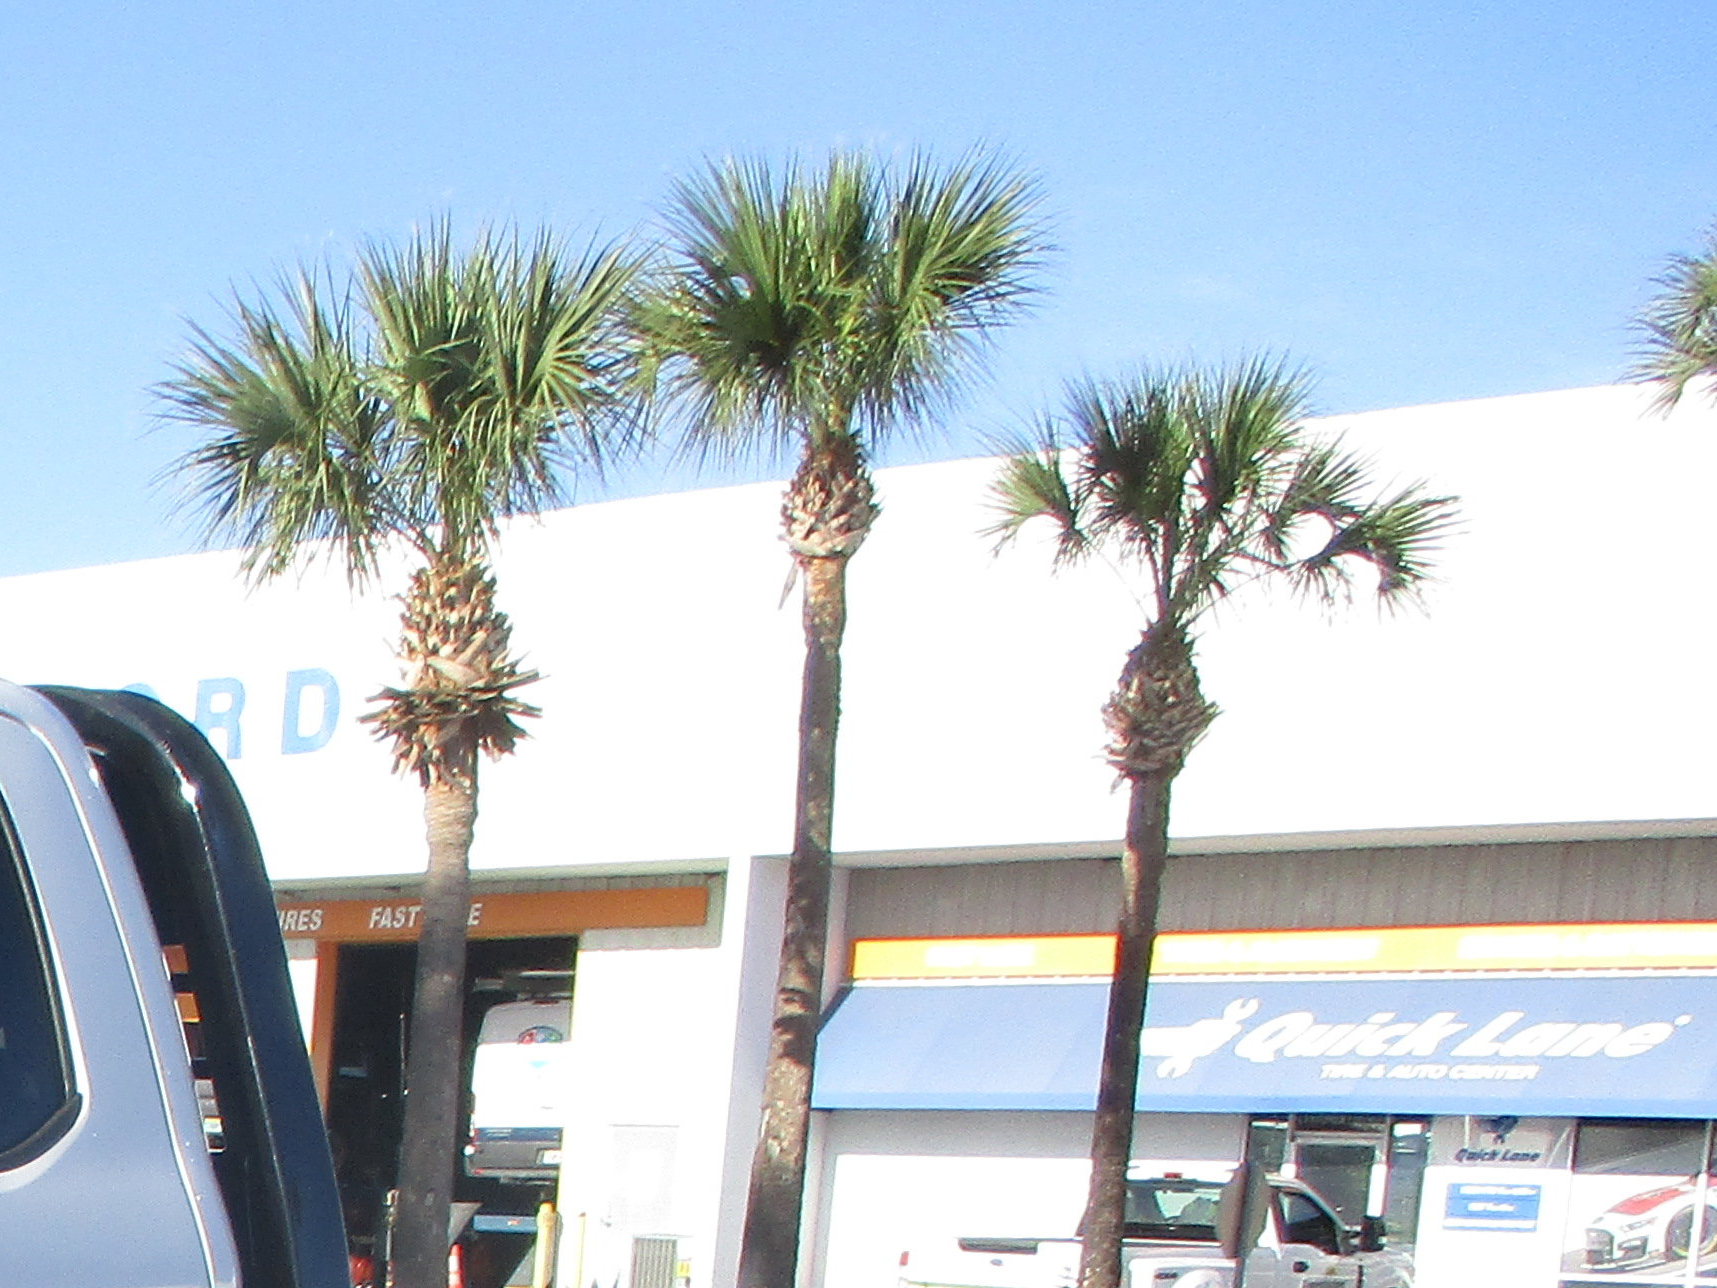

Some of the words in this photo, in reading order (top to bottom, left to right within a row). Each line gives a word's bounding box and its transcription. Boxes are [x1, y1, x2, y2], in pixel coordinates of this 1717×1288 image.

[276, 909, 323, 931] IRES
[369, 905, 422, 929] FAST
[1234, 1011, 1467, 1063] Quick
[1450, 1011, 1675, 1058] Lane
[1320, 1064, 1368, 1079] TIRE
[1367, 1064, 1386, 1079] &
[1386, 1064, 1448, 1079] AUTO
[1449, 1064, 1540, 1080] CENTER
[1454, 1147, 1500, 1163] Quick
[1500, 1148, 1541, 1162] Lane
